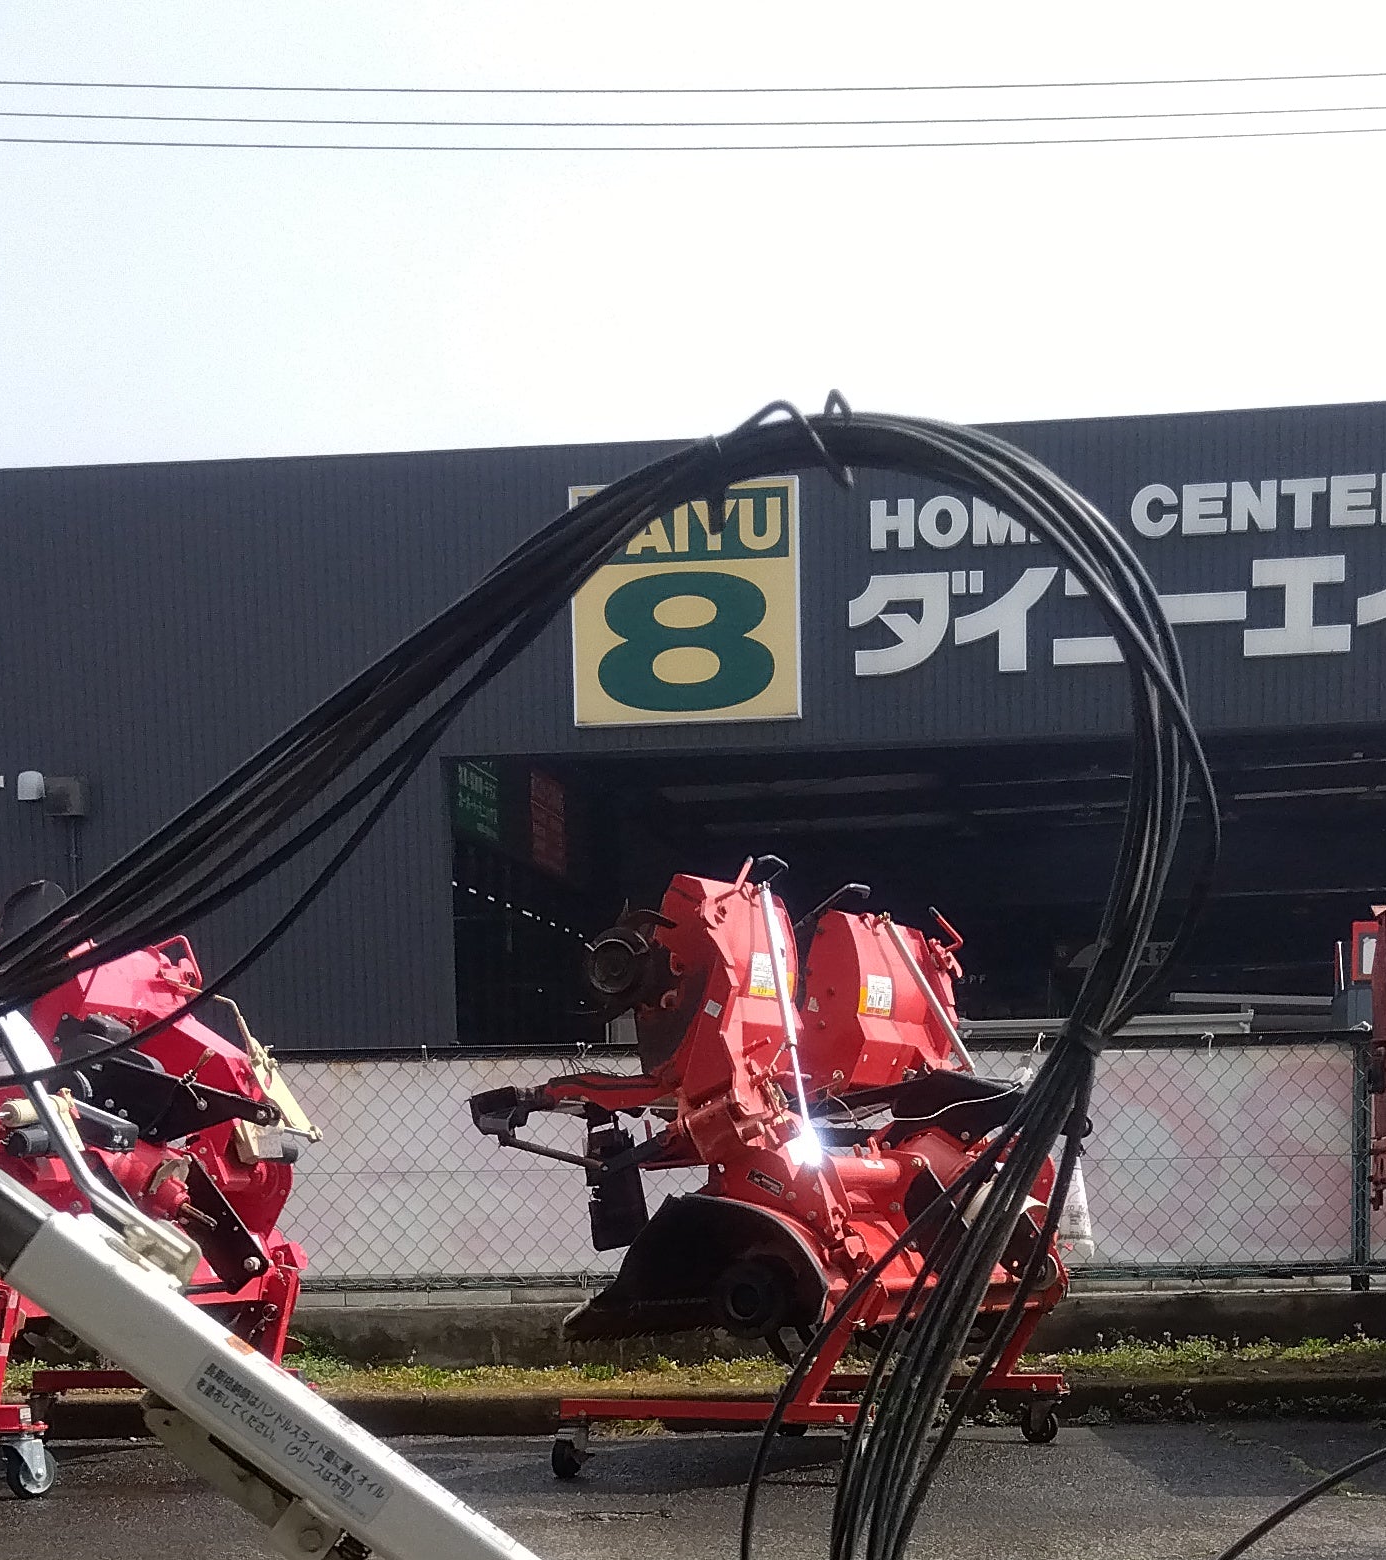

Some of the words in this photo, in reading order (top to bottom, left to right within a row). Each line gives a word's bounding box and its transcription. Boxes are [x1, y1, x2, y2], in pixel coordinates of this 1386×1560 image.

[608, 496, 782, 556] AIYU
[870, 495, 1044, 551] HOM
[598, 571, 775, 712] 8
